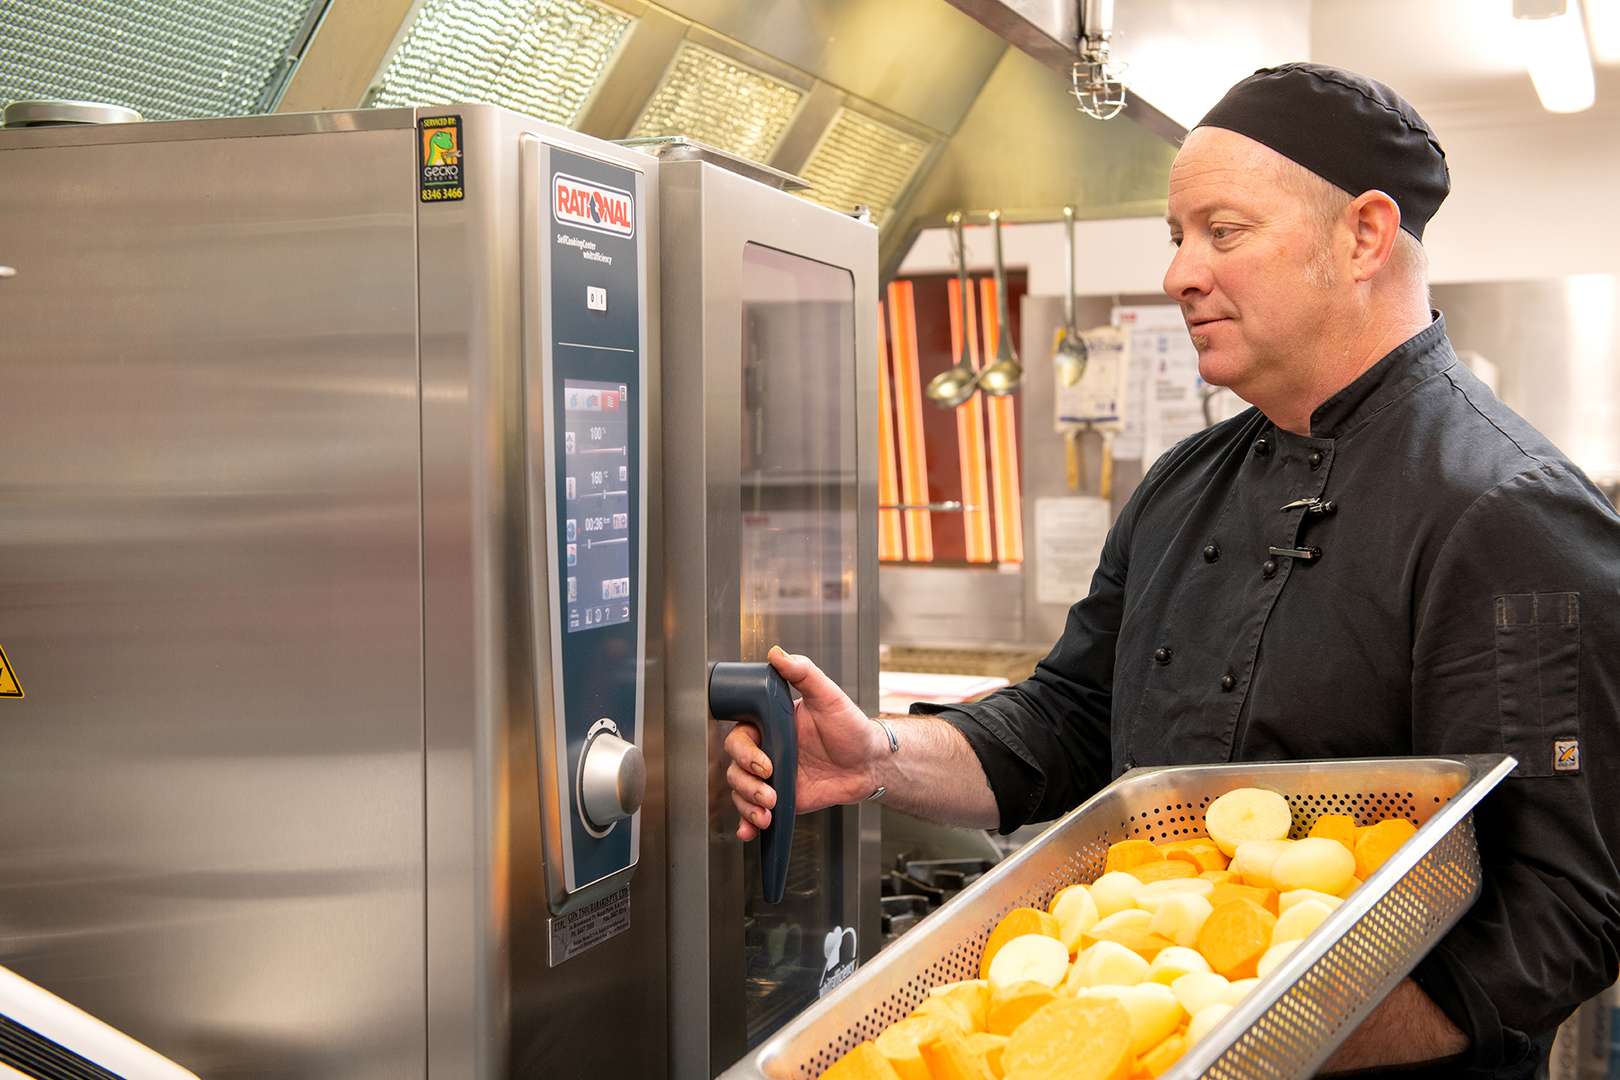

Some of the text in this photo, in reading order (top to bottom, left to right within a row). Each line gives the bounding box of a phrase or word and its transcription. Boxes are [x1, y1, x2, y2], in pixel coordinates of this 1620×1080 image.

[423, 118, 447, 128] SERVICED
[422, 187, 463, 200] 8346 3466
[557, 185, 631, 228] RATIONAL
